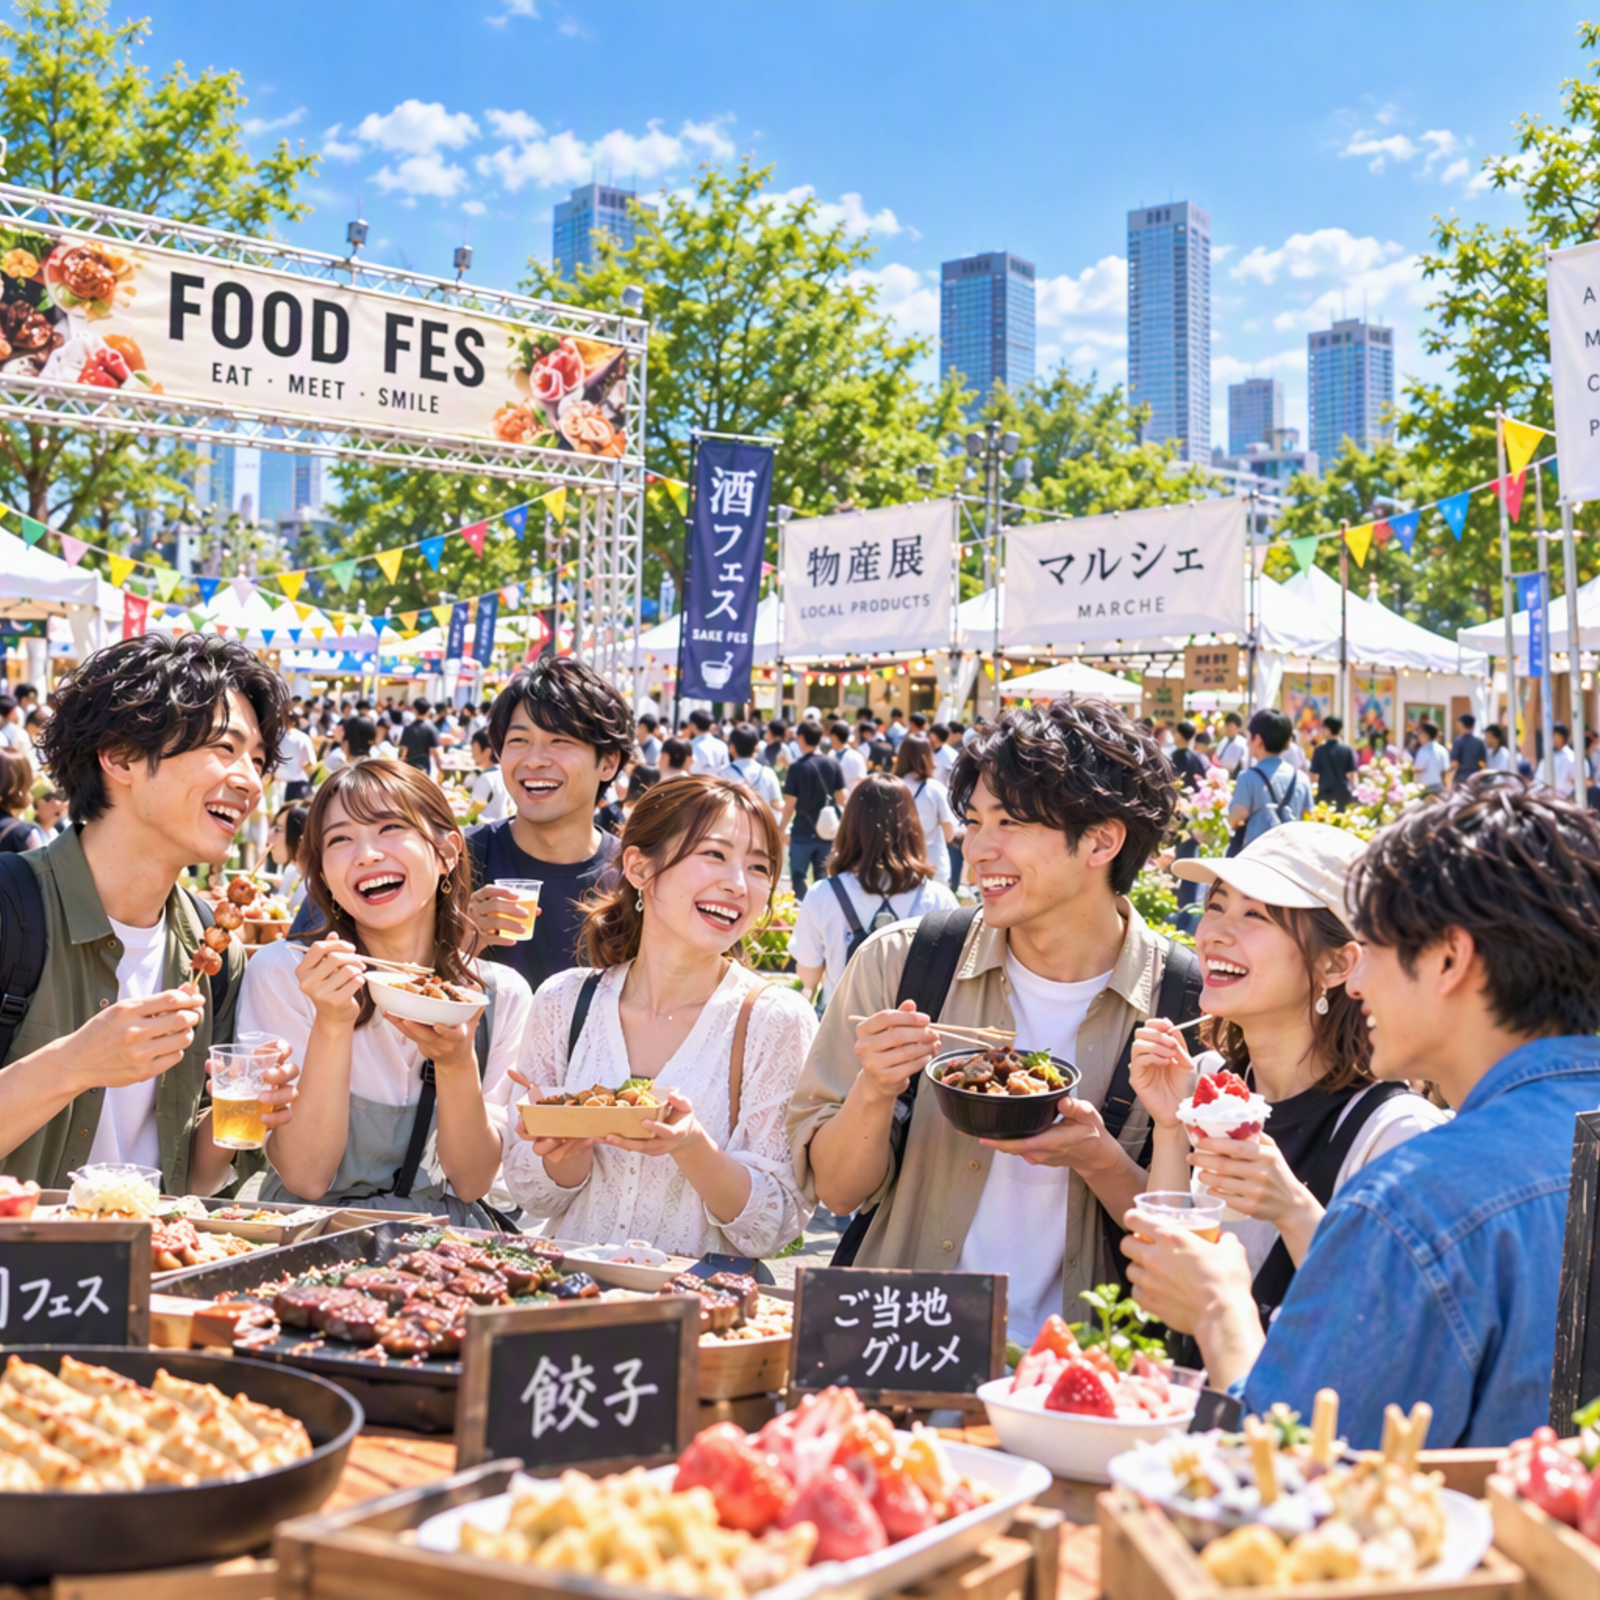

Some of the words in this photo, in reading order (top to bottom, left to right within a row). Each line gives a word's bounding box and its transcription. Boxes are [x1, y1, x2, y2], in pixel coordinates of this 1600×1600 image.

[1583, 286, 1600, 305] A
[169, 271, 350, 365] FOOD
[384, 311, 485, 388] FES
[212, 362, 253, 387] EAT
[288, 374, 345, 400] MEET
[378, 387, 439, 414] SMILE
[705, 466, 757, 621] 酒フェス
[807, 534, 924, 588] 物産展
[1039, 541, 1204, 585] マルシェ
[801, 603, 844, 619] LOCAL
[851, 594, 930, 613] PRODUCTS
[1077, 597, 1164, 618] MARCHE
[692, 628, 723, 643] SAKE
[726, 631, 748, 644] FES
[0, 1266, 110, 1330] フェス
[834, 1285, 952, 1329] ご当地
[862, 1332, 960, 1377] グルメ
[520, 1354, 659, 1439] 餃子
